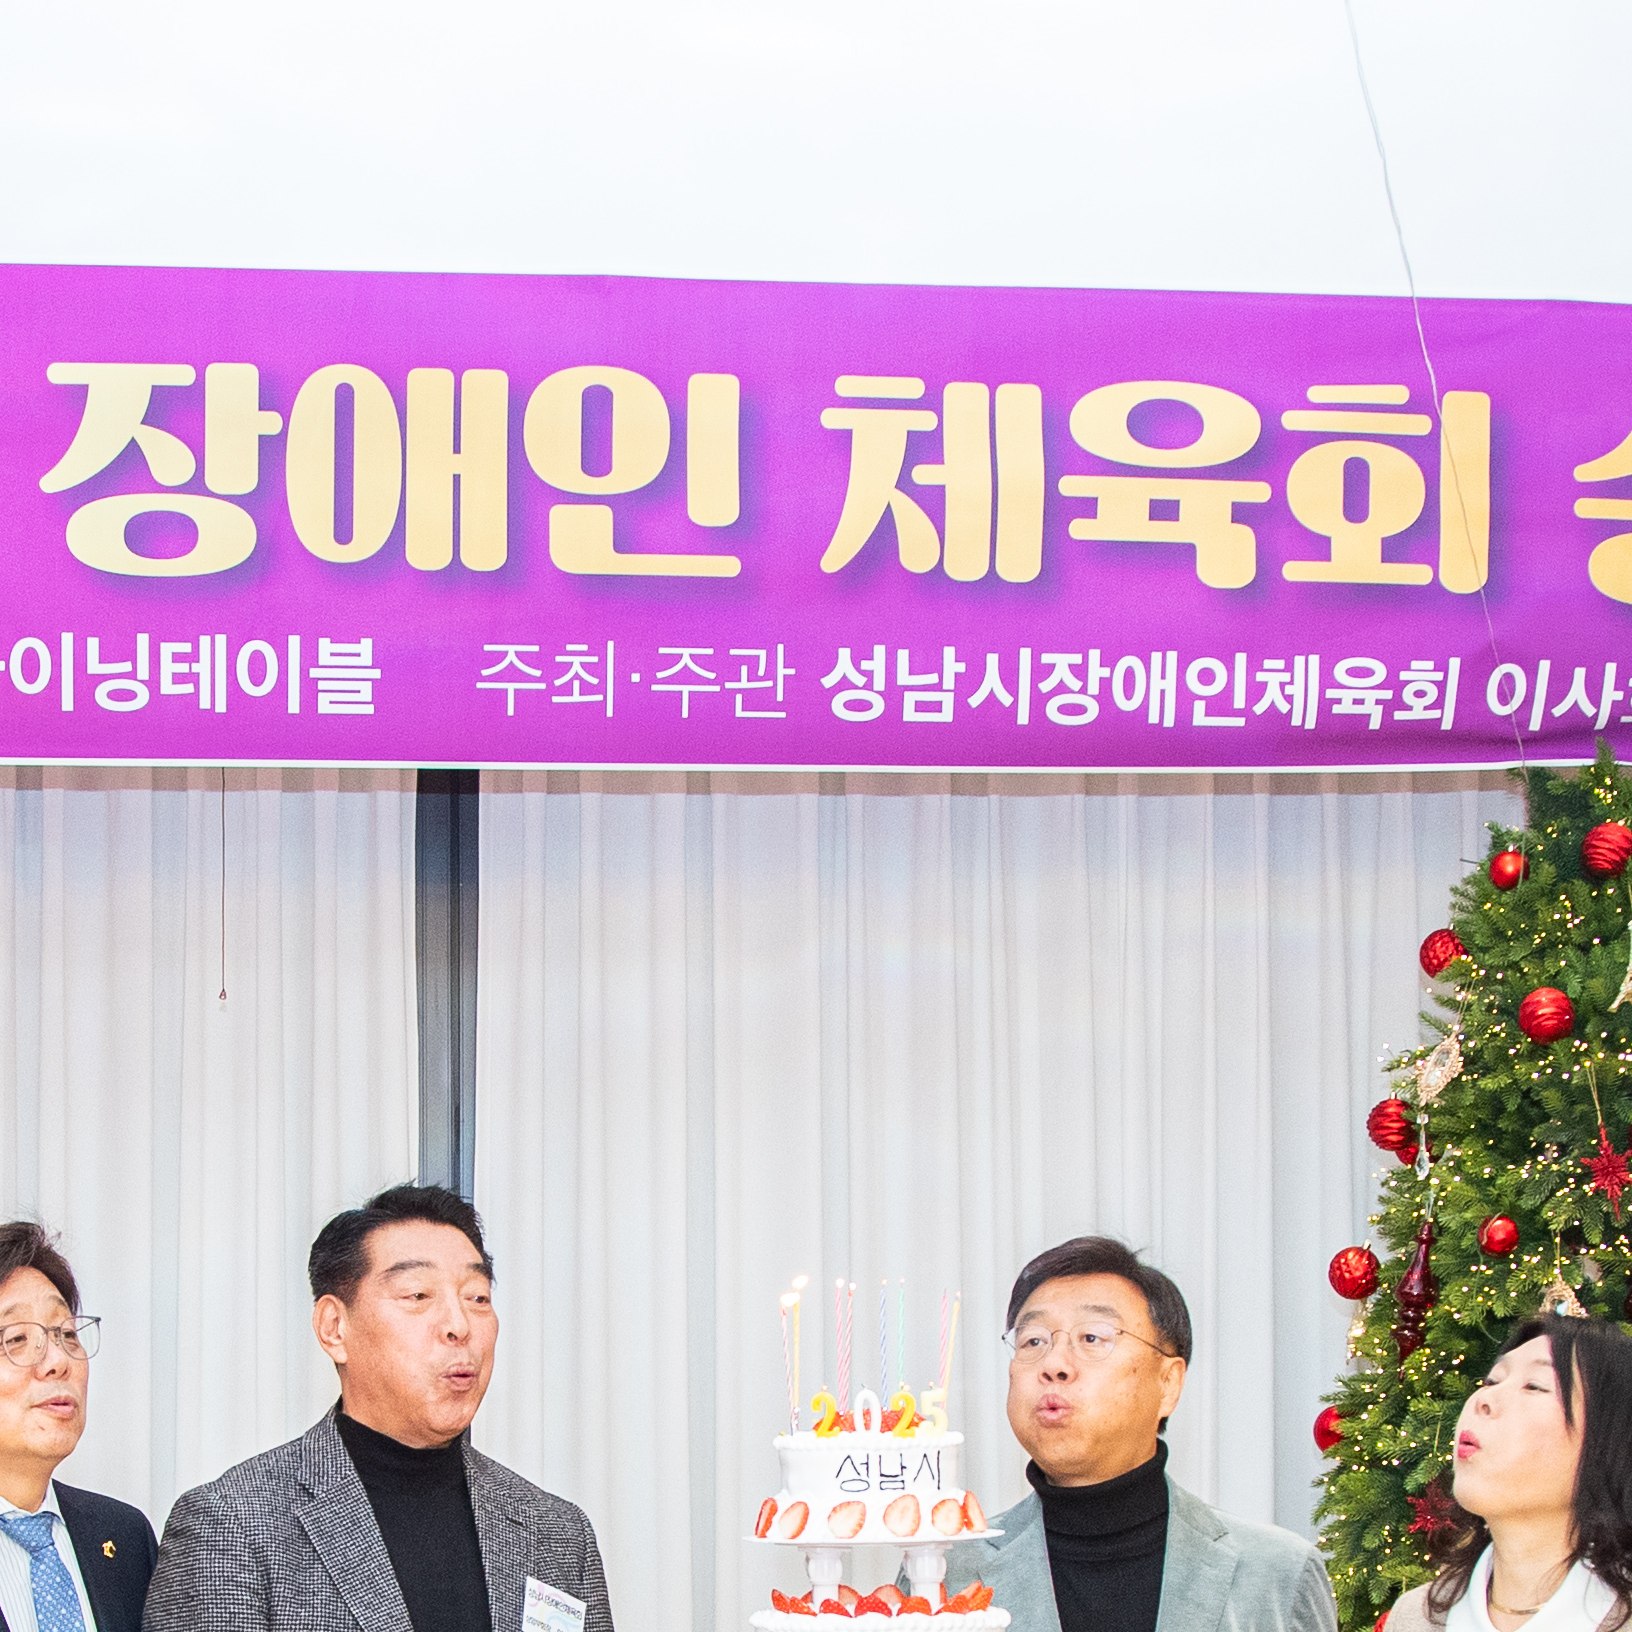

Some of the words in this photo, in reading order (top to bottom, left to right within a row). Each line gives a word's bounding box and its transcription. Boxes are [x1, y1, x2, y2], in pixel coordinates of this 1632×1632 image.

[39, 362, 741, 577] 장애인
[820, 374, 1490, 594] 체육회
[820, 645, 1460, 730] 성남시장애인체육회
[835, 1450, 942, 1493] 성남시
